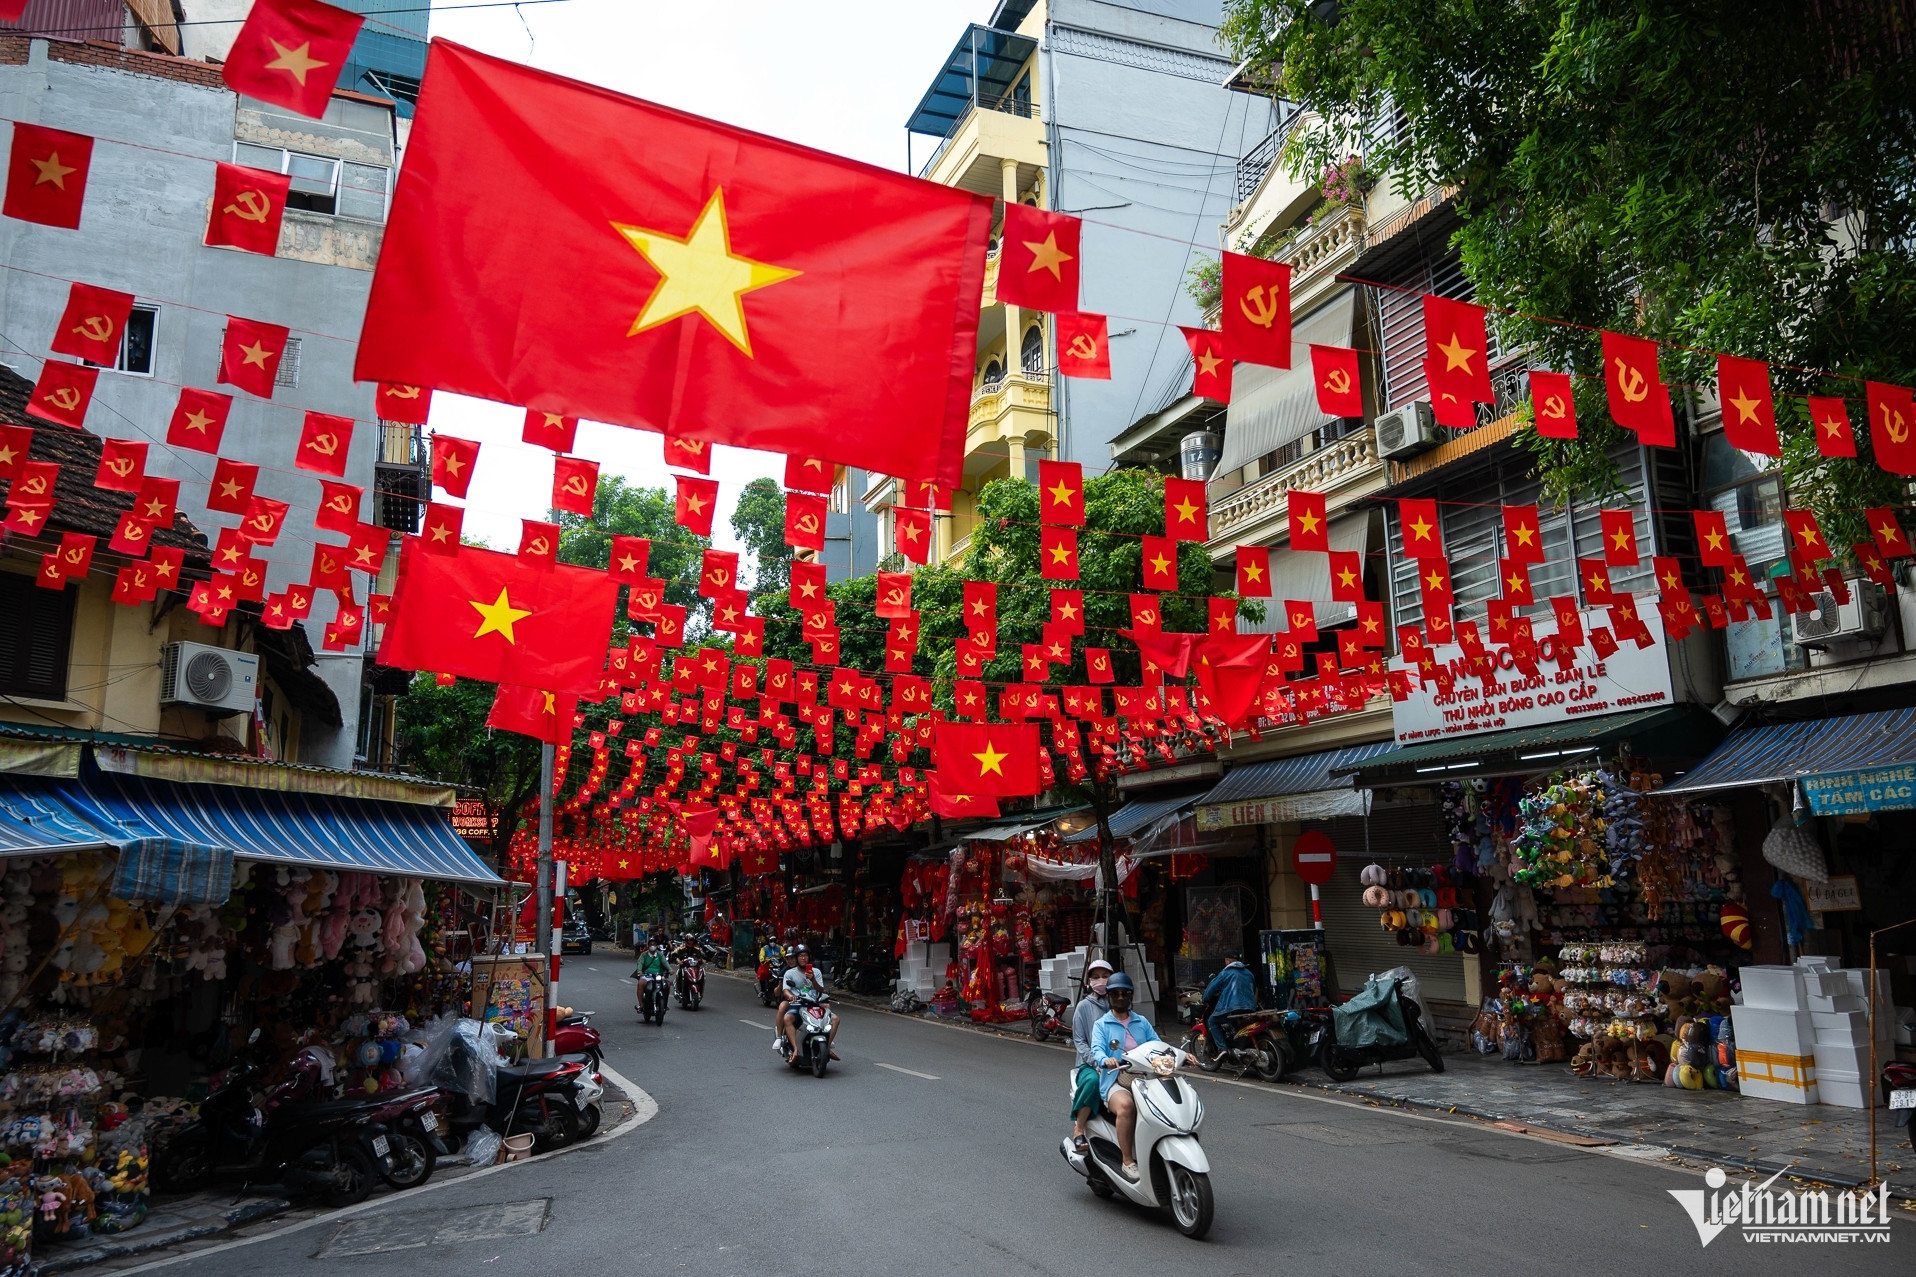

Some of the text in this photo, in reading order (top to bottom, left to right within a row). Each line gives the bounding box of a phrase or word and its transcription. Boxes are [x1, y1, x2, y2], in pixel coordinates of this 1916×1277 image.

[1443, 705, 1464, 722] THÚ
[1498, 696, 1534, 713] BÔNG
[1537, 690, 1565, 707] CAO
[1569, 680, 1597, 701] CẤP
[1232, 801, 1265, 824] LIÊN
